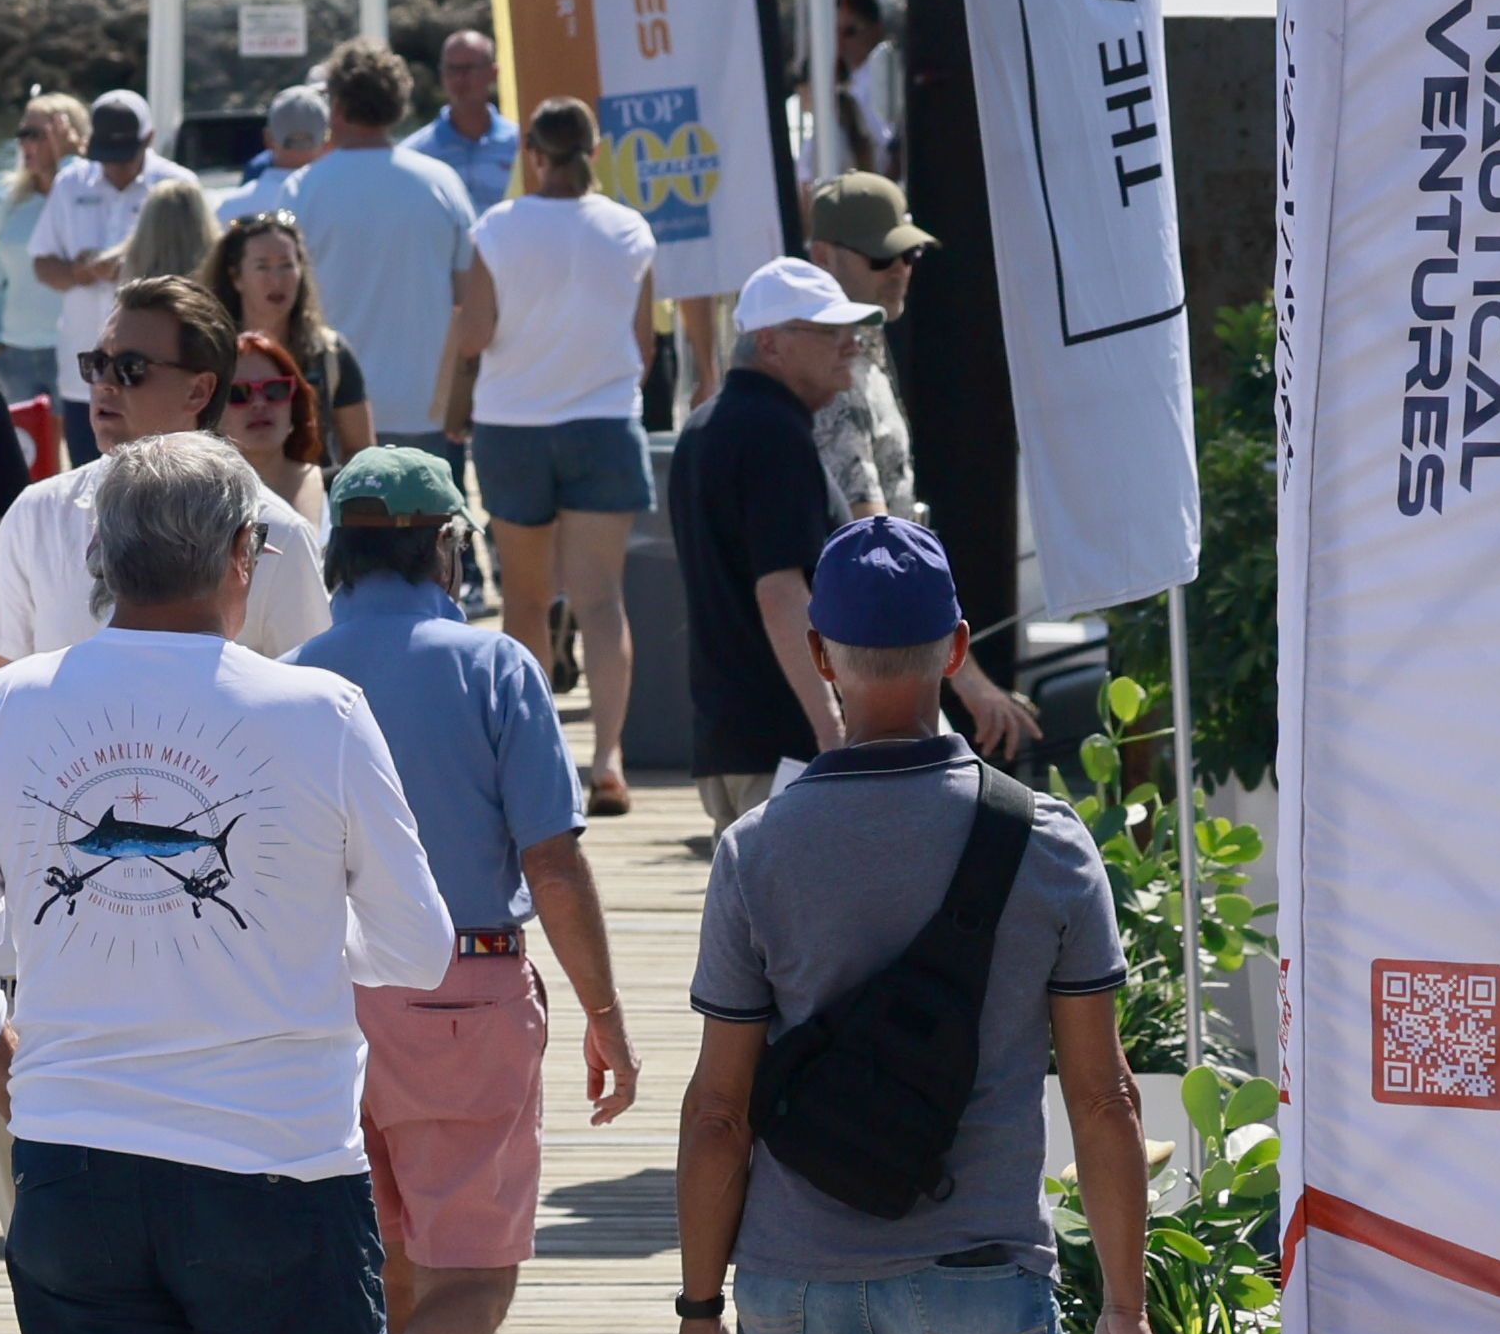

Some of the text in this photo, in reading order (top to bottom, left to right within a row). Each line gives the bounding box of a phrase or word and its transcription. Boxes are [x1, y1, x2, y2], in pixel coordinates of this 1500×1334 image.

[611, 91, 684, 127] TOP
[1098, 30, 1163, 208] THE
[56, 742, 219, 789] BLUE MARLIN MARINA
[108, 900, 134, 916] REPAIR
